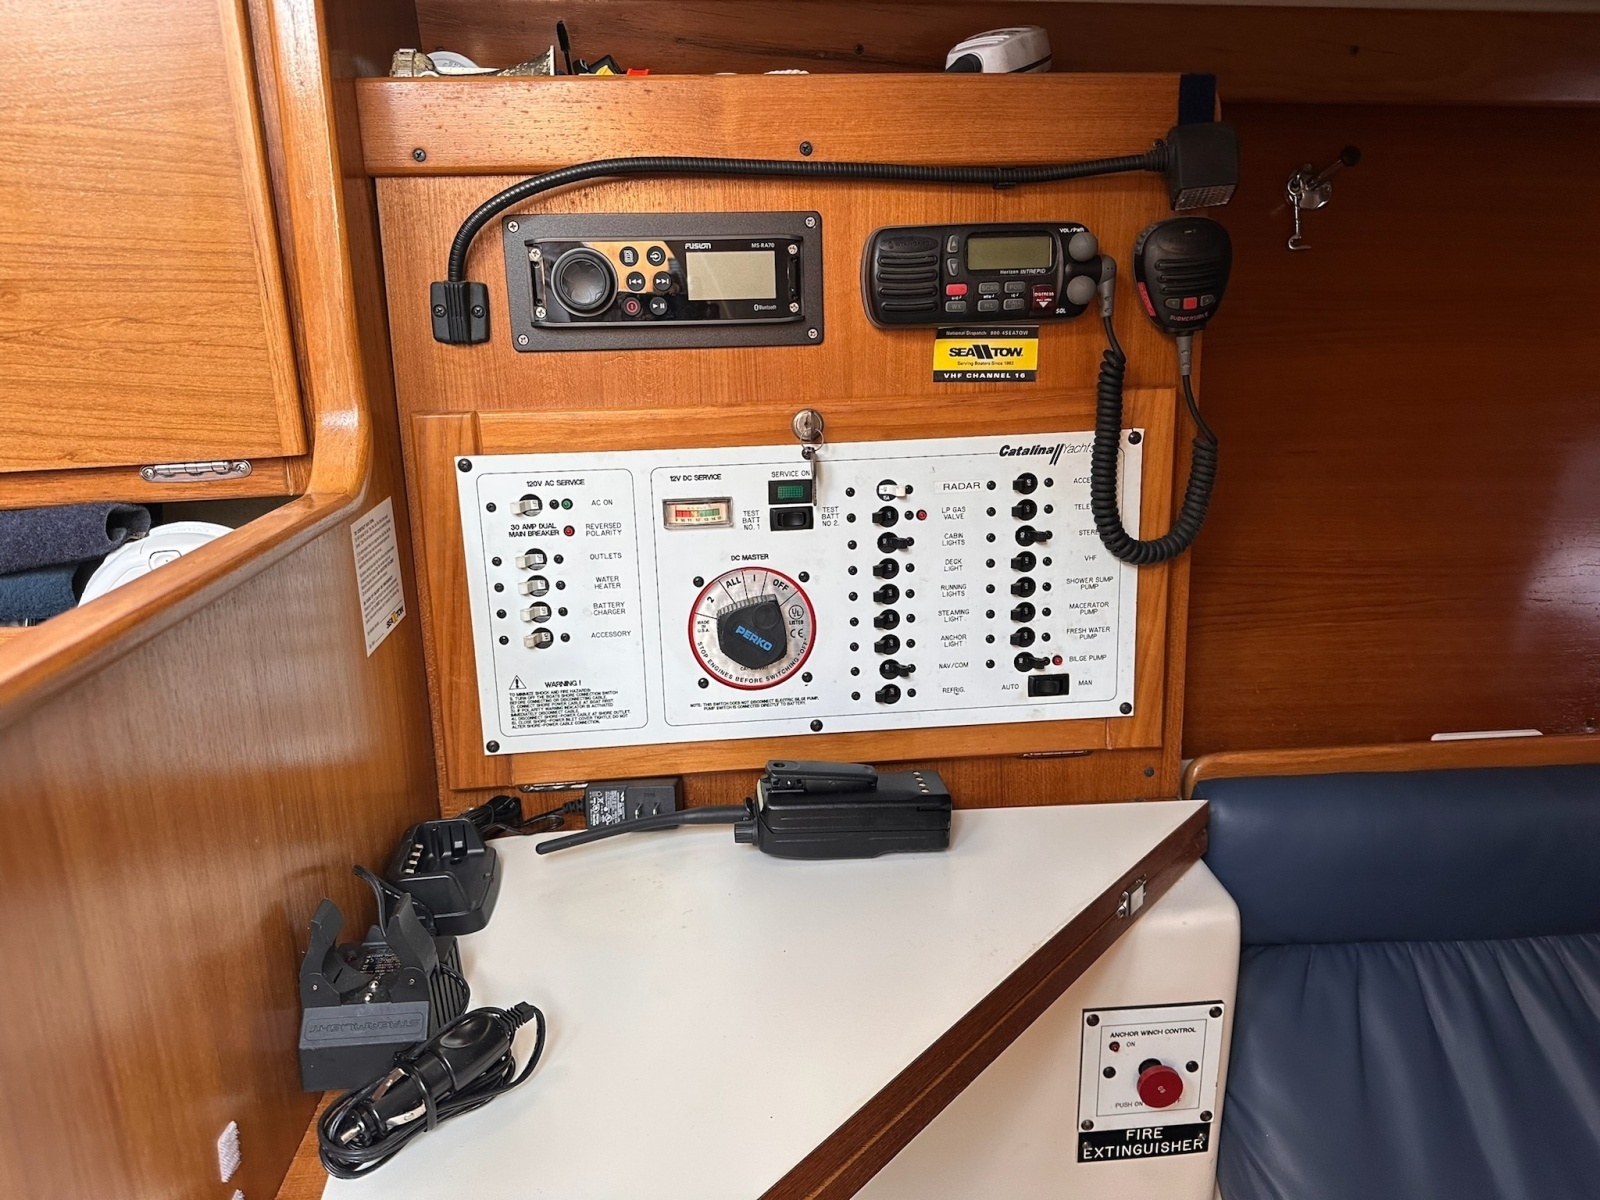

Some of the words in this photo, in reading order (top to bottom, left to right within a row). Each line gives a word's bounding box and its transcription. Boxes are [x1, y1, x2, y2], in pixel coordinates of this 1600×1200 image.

[1170, 312, 1208, 321] SUBMERSIBLE
[999, 444, 1055, 457] Catalina
[942, 482, 981, 491] RADAR
[725, 577, 742, 588] ALL
[772, 579, 790, 592] OFF
[591, 630, 632, 639] ACCESSORY
[735, 625, 773, 651] PERKO
[697, 641, 708, 658] STOP
[707, 659, 733, 679] ENGINES
[766, 657, 799, 681] SWITCHING
[1126, 1127, 1164, 1141] FIRE
[1083, 1139, 1204, 1160] EXTINGUISHER
